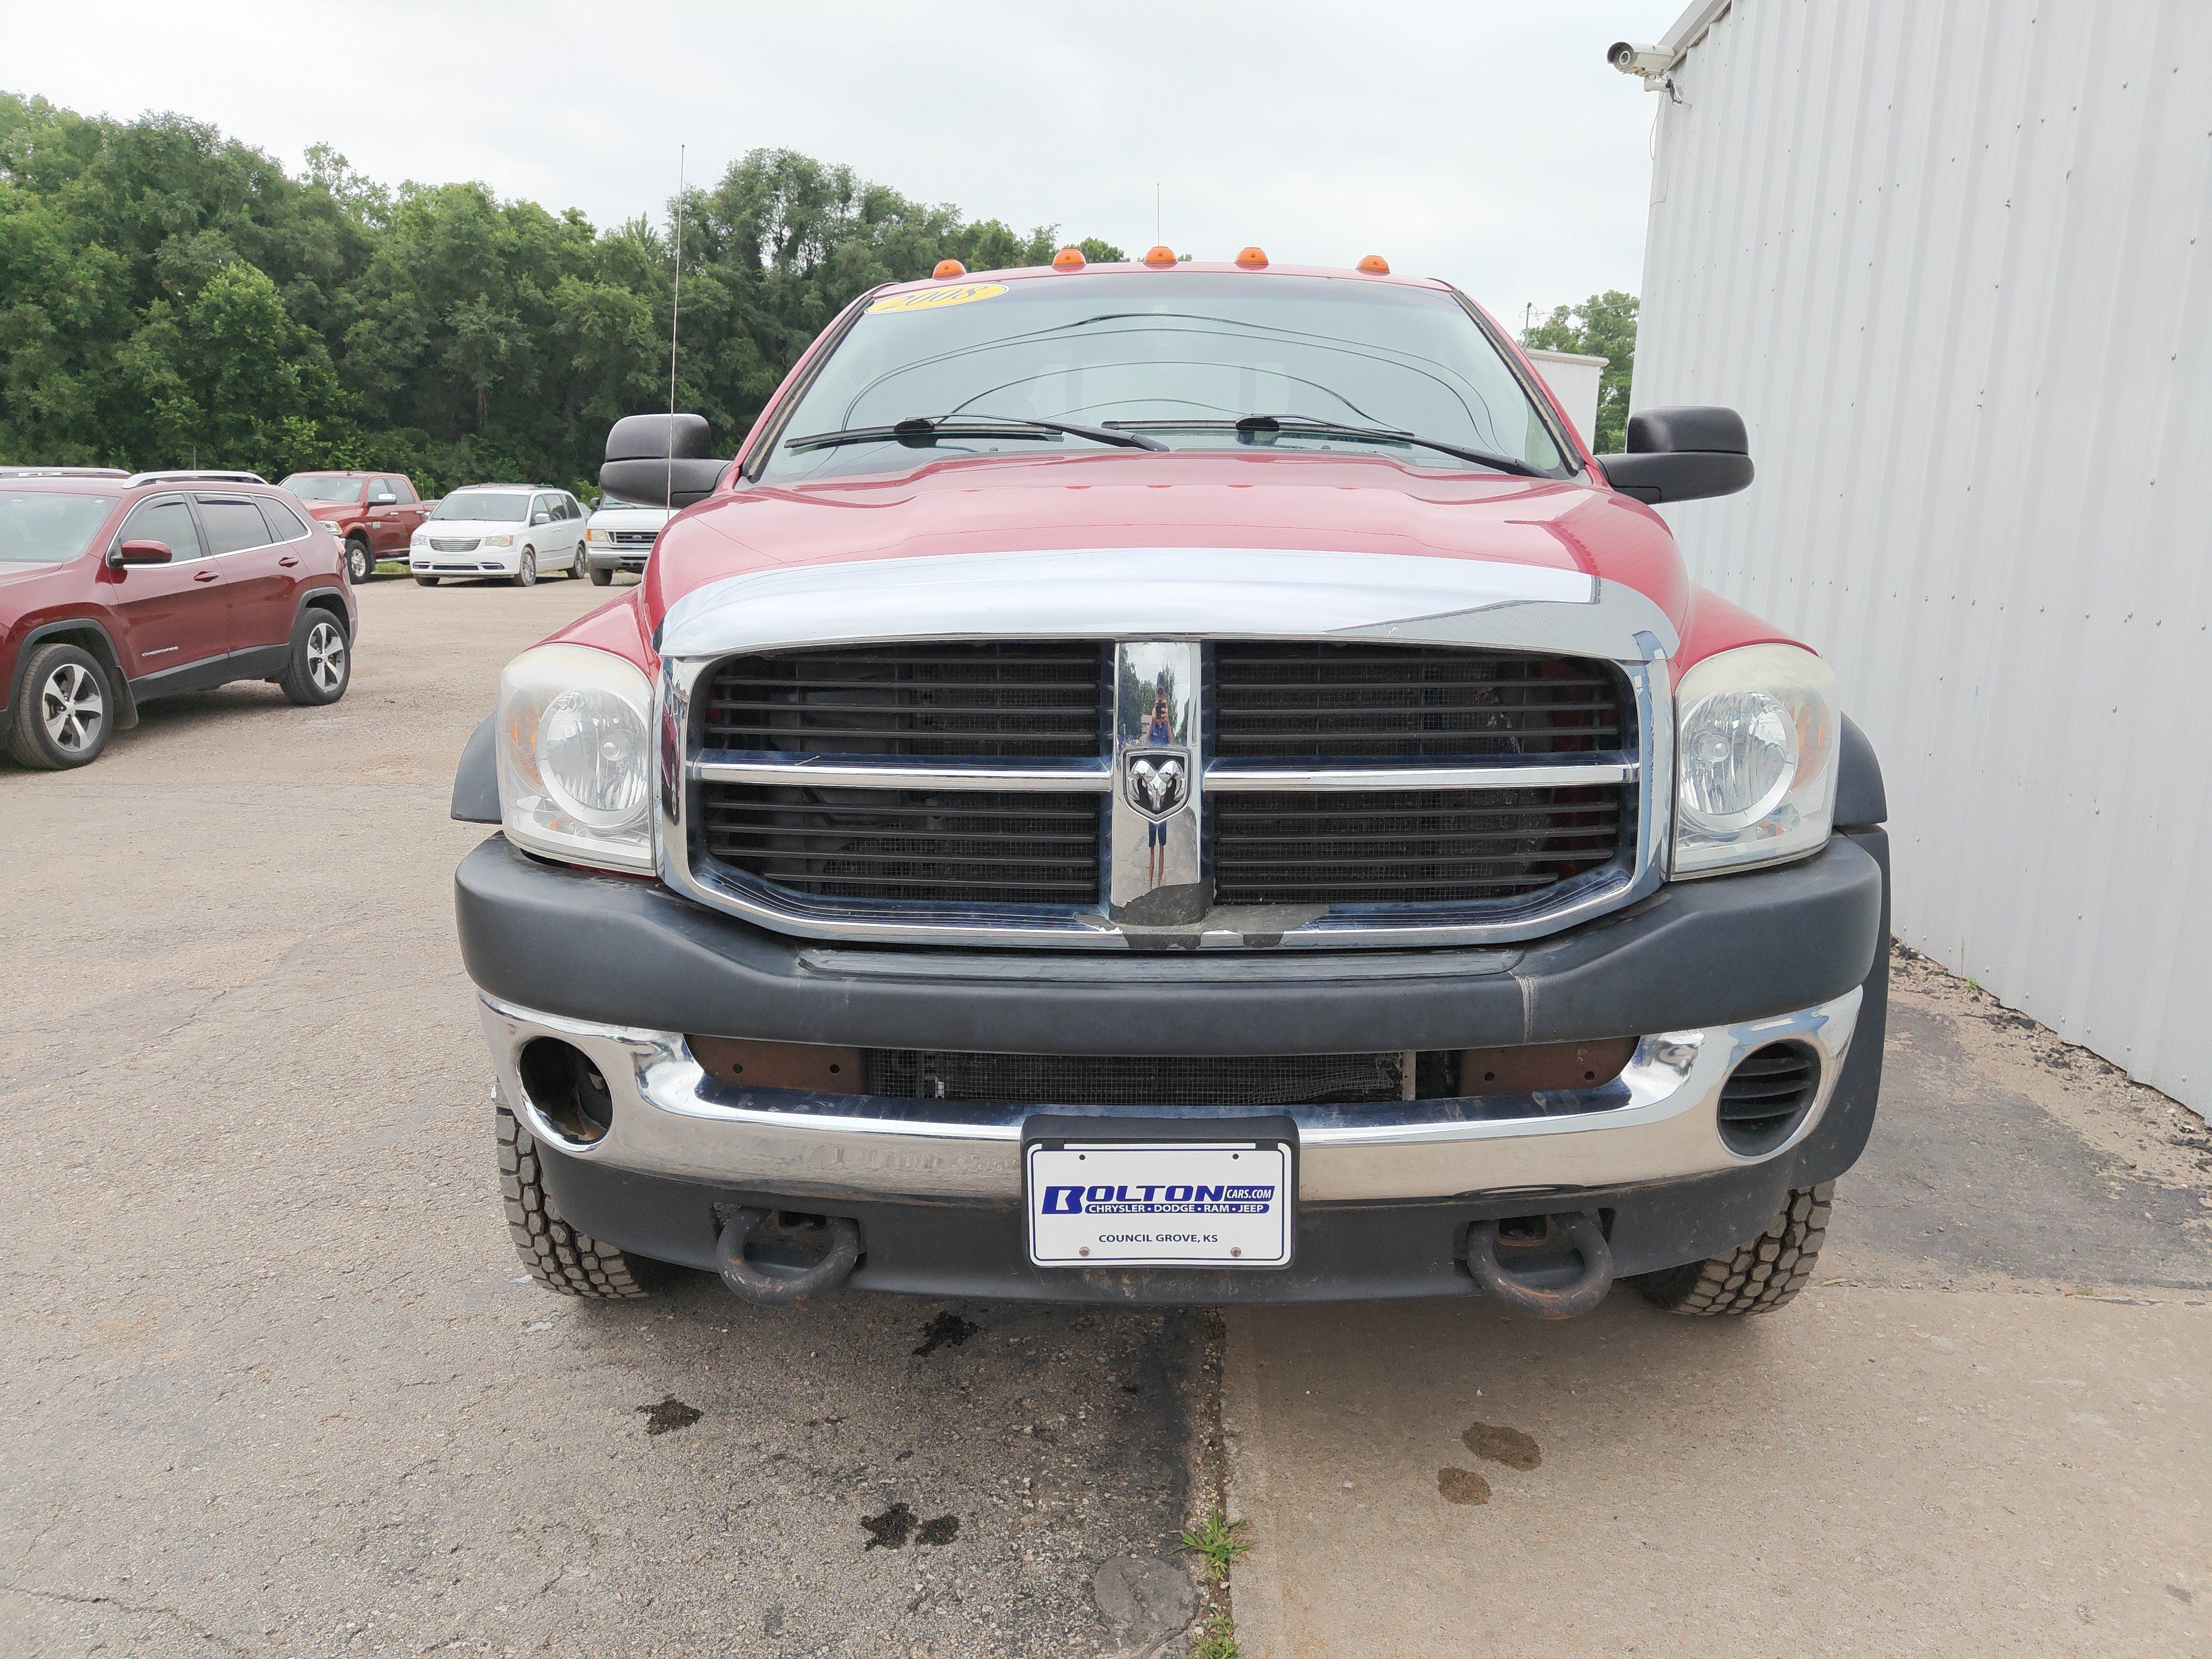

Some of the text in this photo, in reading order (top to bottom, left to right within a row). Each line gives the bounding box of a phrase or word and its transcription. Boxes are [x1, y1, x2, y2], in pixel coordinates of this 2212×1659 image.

[877, 286, 988, 311] 2008
[1041, 1185, 1272, 1215] BOLTON CARS.COM
[1088, 1204, 1264, 1213] CHRYSLER DODGE RAM JEEP
[1098, 1234, 1218, 1244] COUNCIL GROVE, KS
